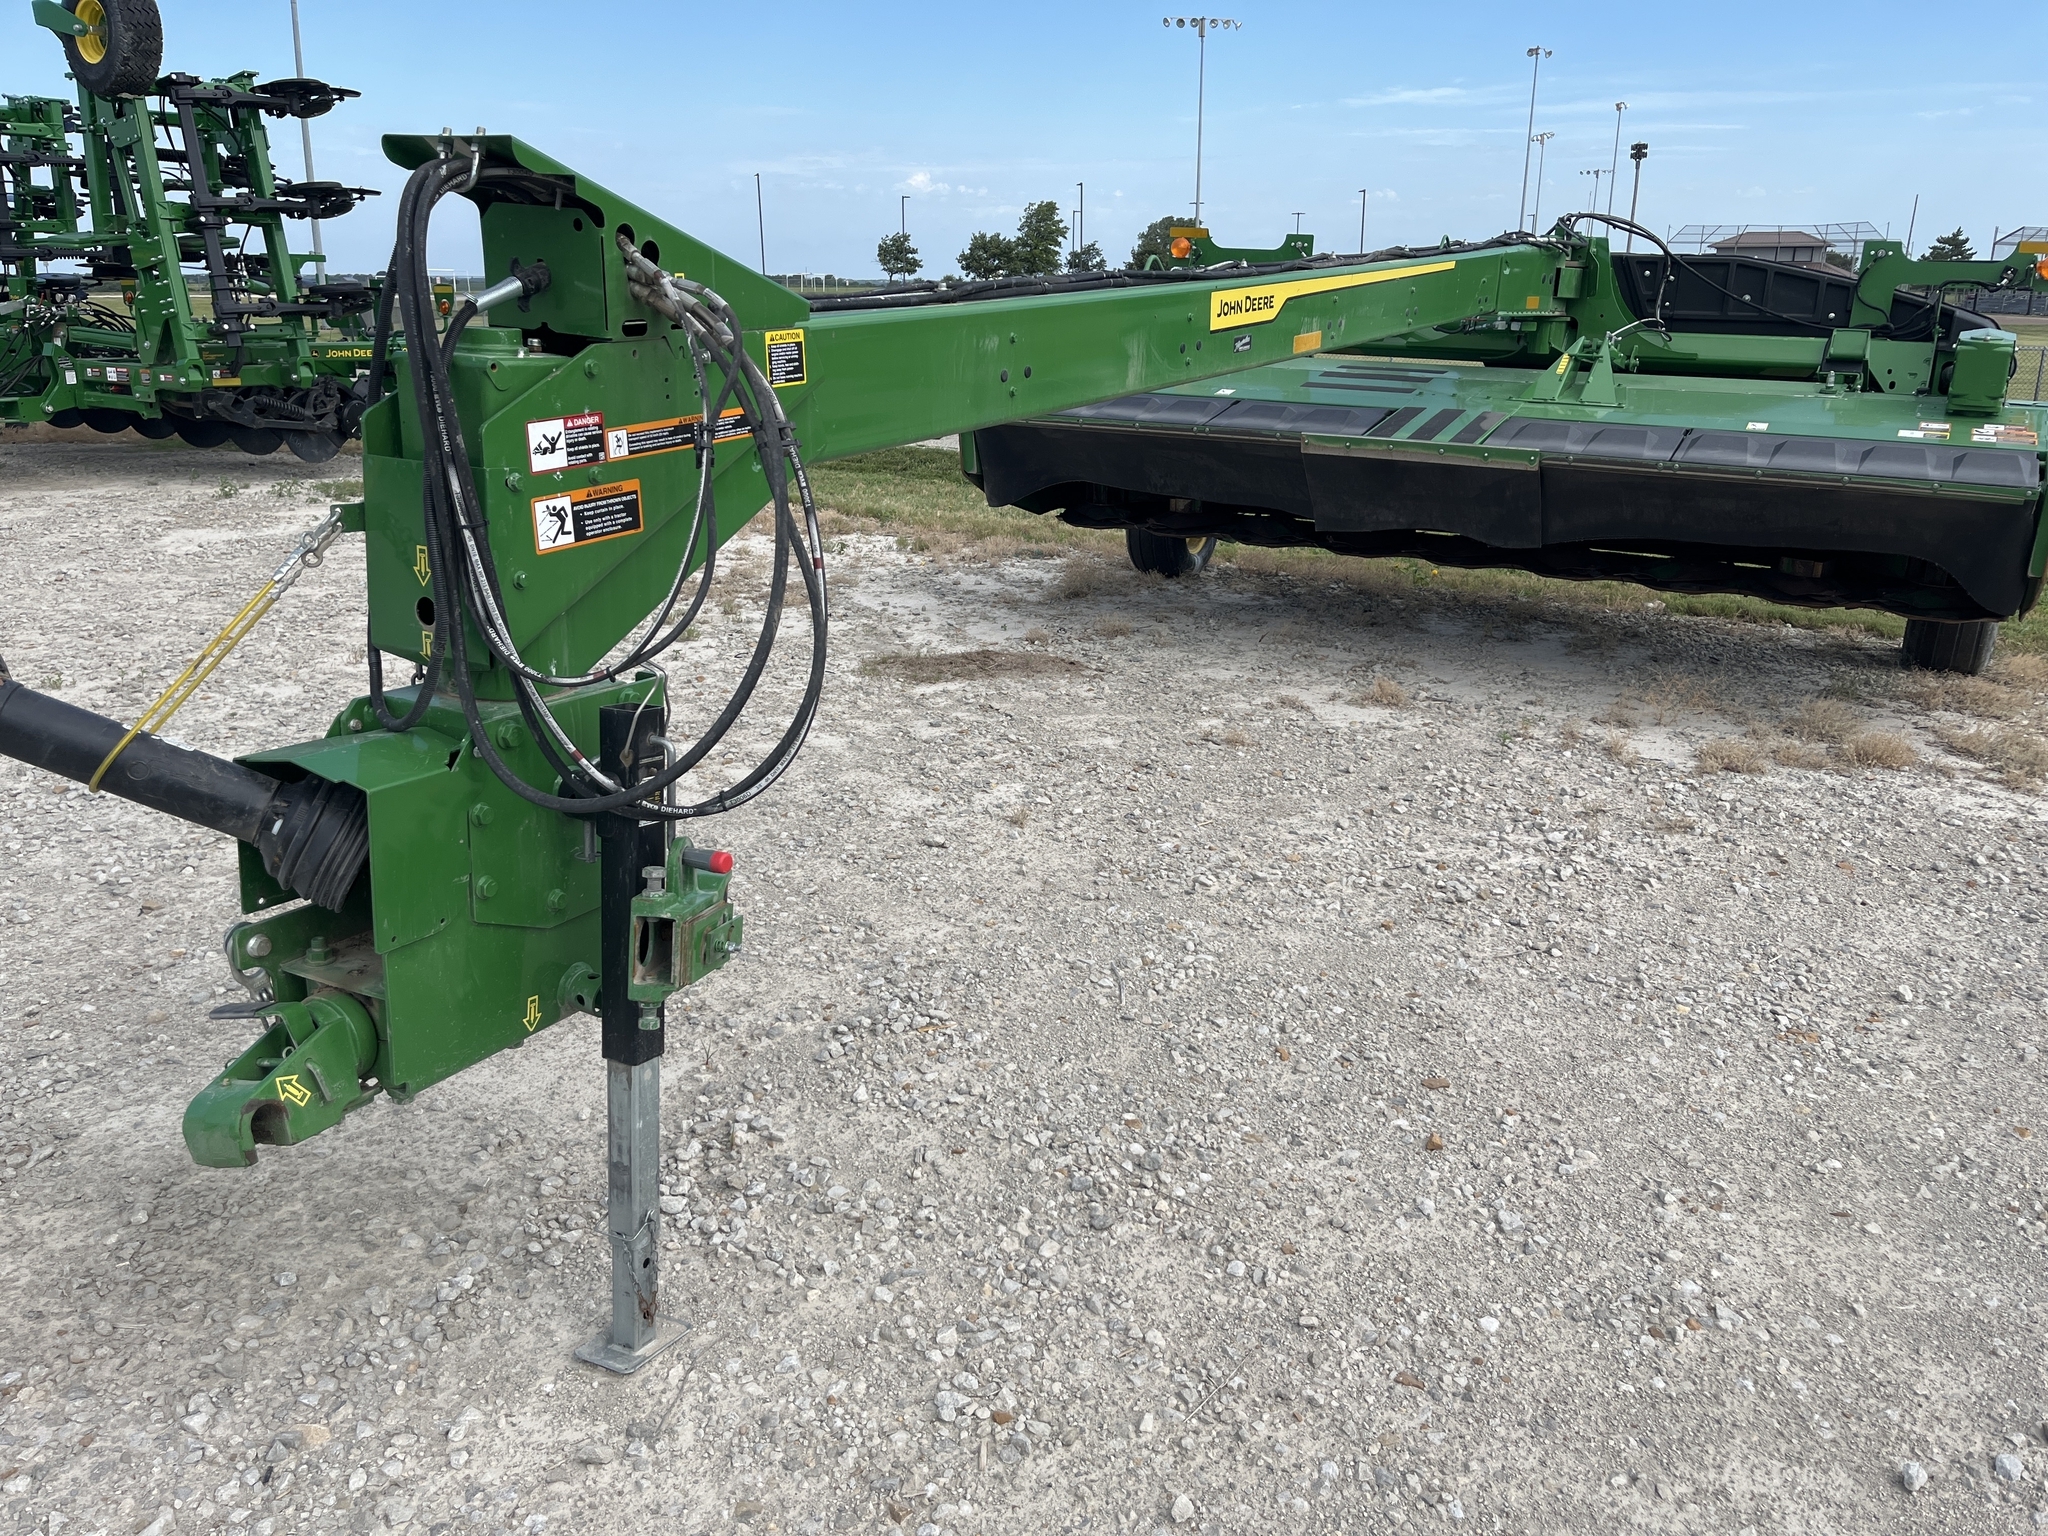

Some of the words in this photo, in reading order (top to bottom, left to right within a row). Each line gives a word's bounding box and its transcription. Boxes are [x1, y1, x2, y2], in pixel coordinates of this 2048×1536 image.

[1217, 299, 1243, 318] JOHN
[1244, 294, 1275, 313] DEERE
[774, 332, 800, 342] CAUTION
[326, 348, 352, 358] JOHN
[353, 348, 373, 357] DEE
[573, 416, 600, 426] DANGER
[683, 414, 704, 424] WARNIN
[438, 415, 452, 452] DIEHARD
[592, 484, 623, 496] WARNING
[488, 627, 510, 656] DIEHARD
[660, 806, 694, 815] DIEHARD
